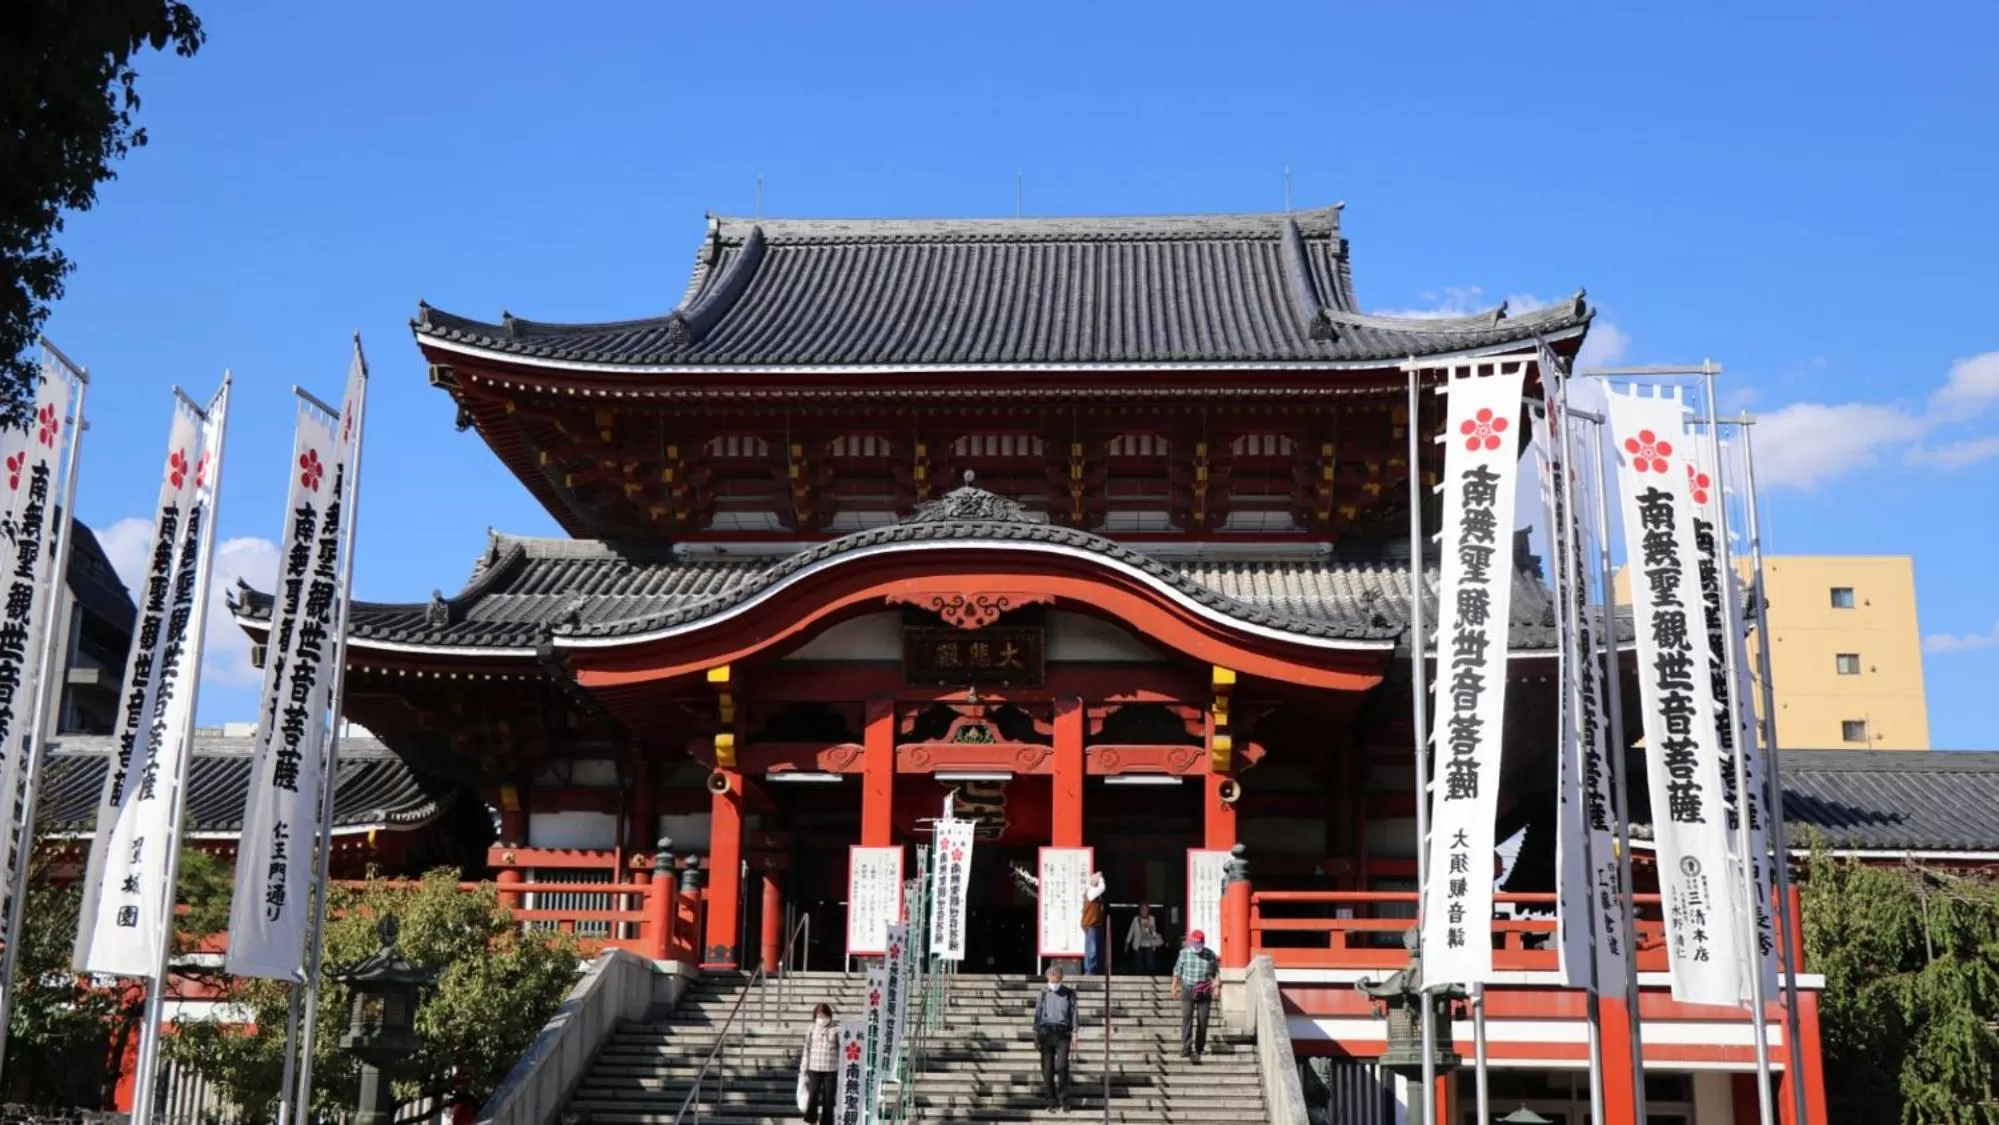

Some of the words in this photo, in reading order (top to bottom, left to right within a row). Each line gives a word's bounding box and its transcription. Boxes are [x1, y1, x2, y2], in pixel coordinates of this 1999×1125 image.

[1636, 486, 1707, 824] 南無聖観世音菩薩
[266, 820, 289, 922] 仁王門通り
